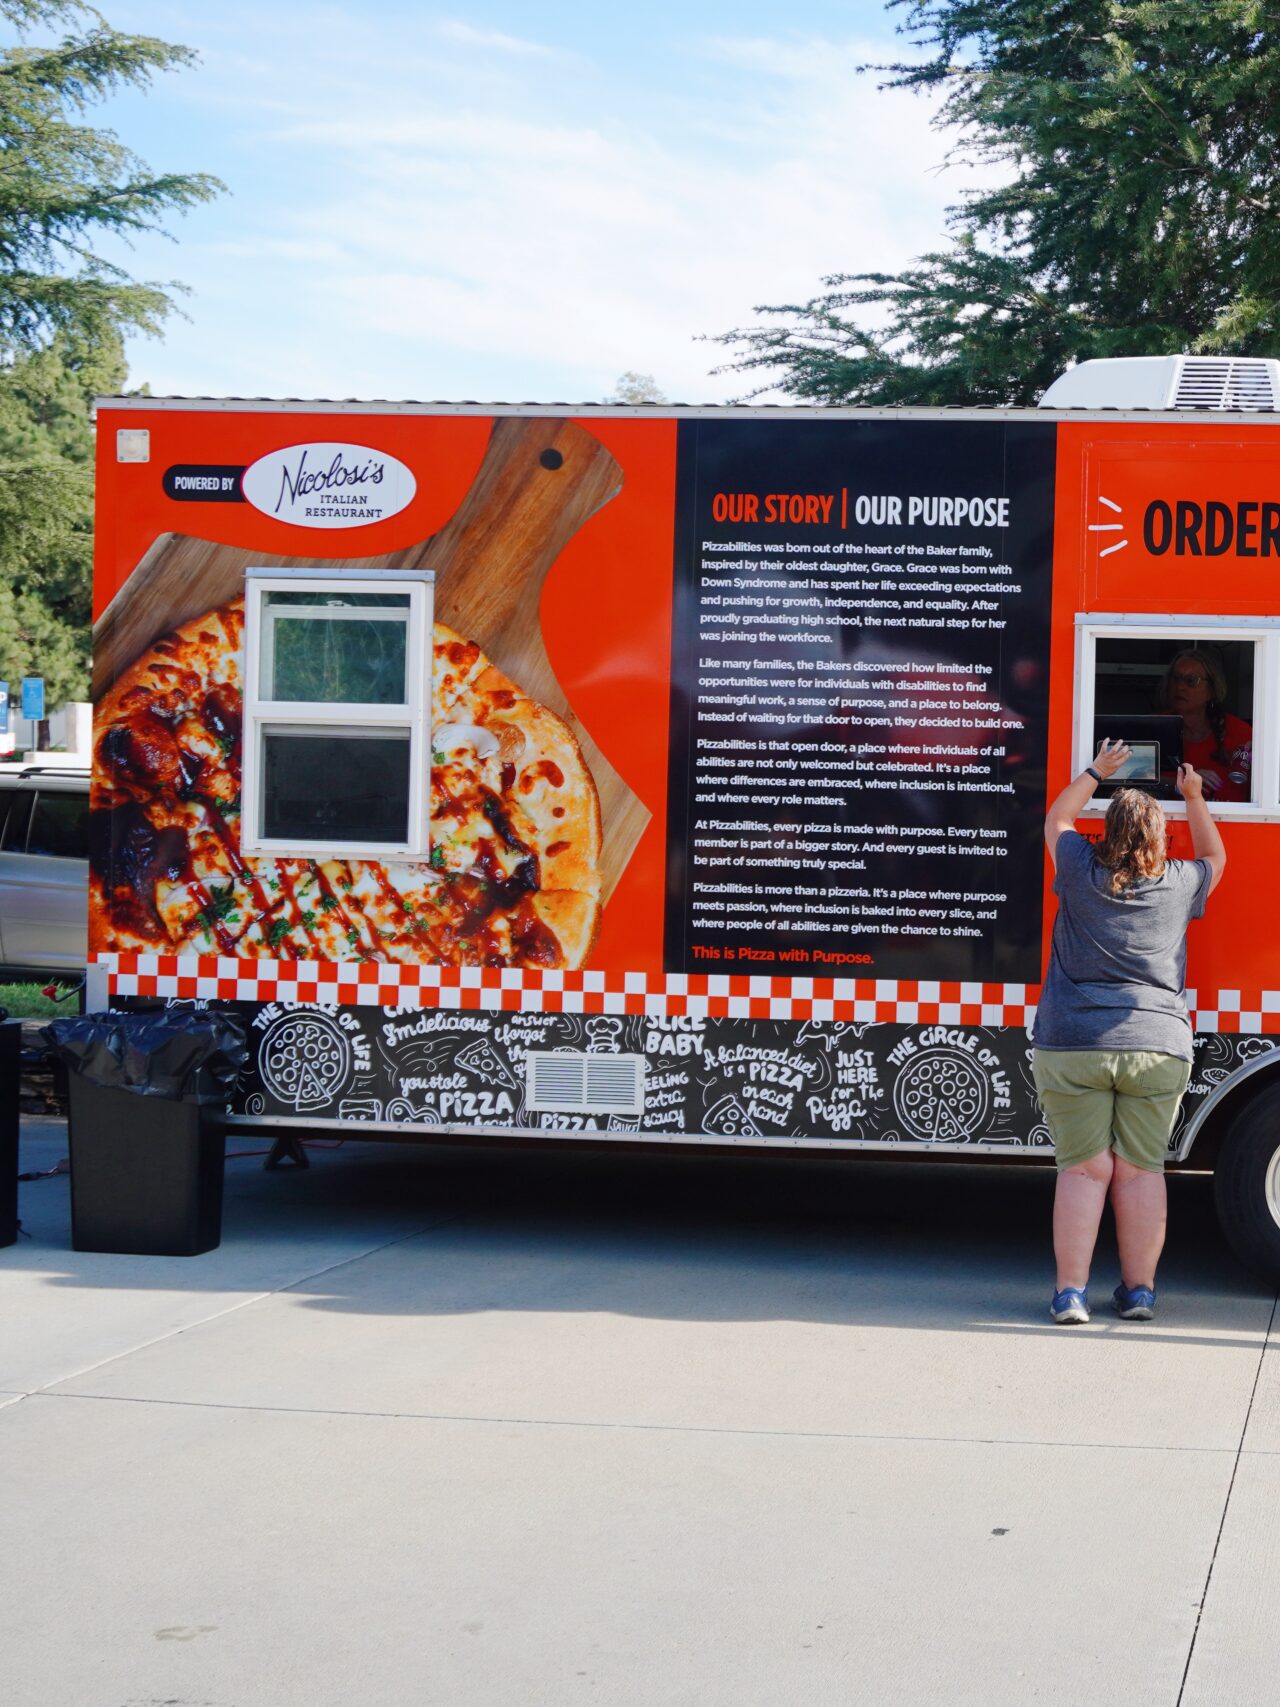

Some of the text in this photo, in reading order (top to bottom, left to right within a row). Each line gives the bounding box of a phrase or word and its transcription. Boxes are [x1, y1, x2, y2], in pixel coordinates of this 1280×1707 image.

[174, 476, 235, 491] POWERED BY
[320, 494, 368, 504] ITALIAN
[305, 508, 383, 518] RESTAURANT
[712, 493, 1010, 527] OUR STORY OUR PURPOSE
[702, 541, 993, 558] Pizzabilities was born out of the heart of the Baker family,
[701, 558, 1013, 575] inspired by their oldest daughter, Grace. Grace was born with
[701, 576, 1022, 594] Down Syndrome and has spent her life exceeding expectations
[691, 945, 875, 966] This is Pizza with Purpose.
[645, 1030, 706, 1056] BABY
[835, 1049, 874, 1068] JUST
[886, 1037, 918, 1067] THE
[977, 1048, 1000, 1067] OF
[837, 1068, 879, 1085] HERE
